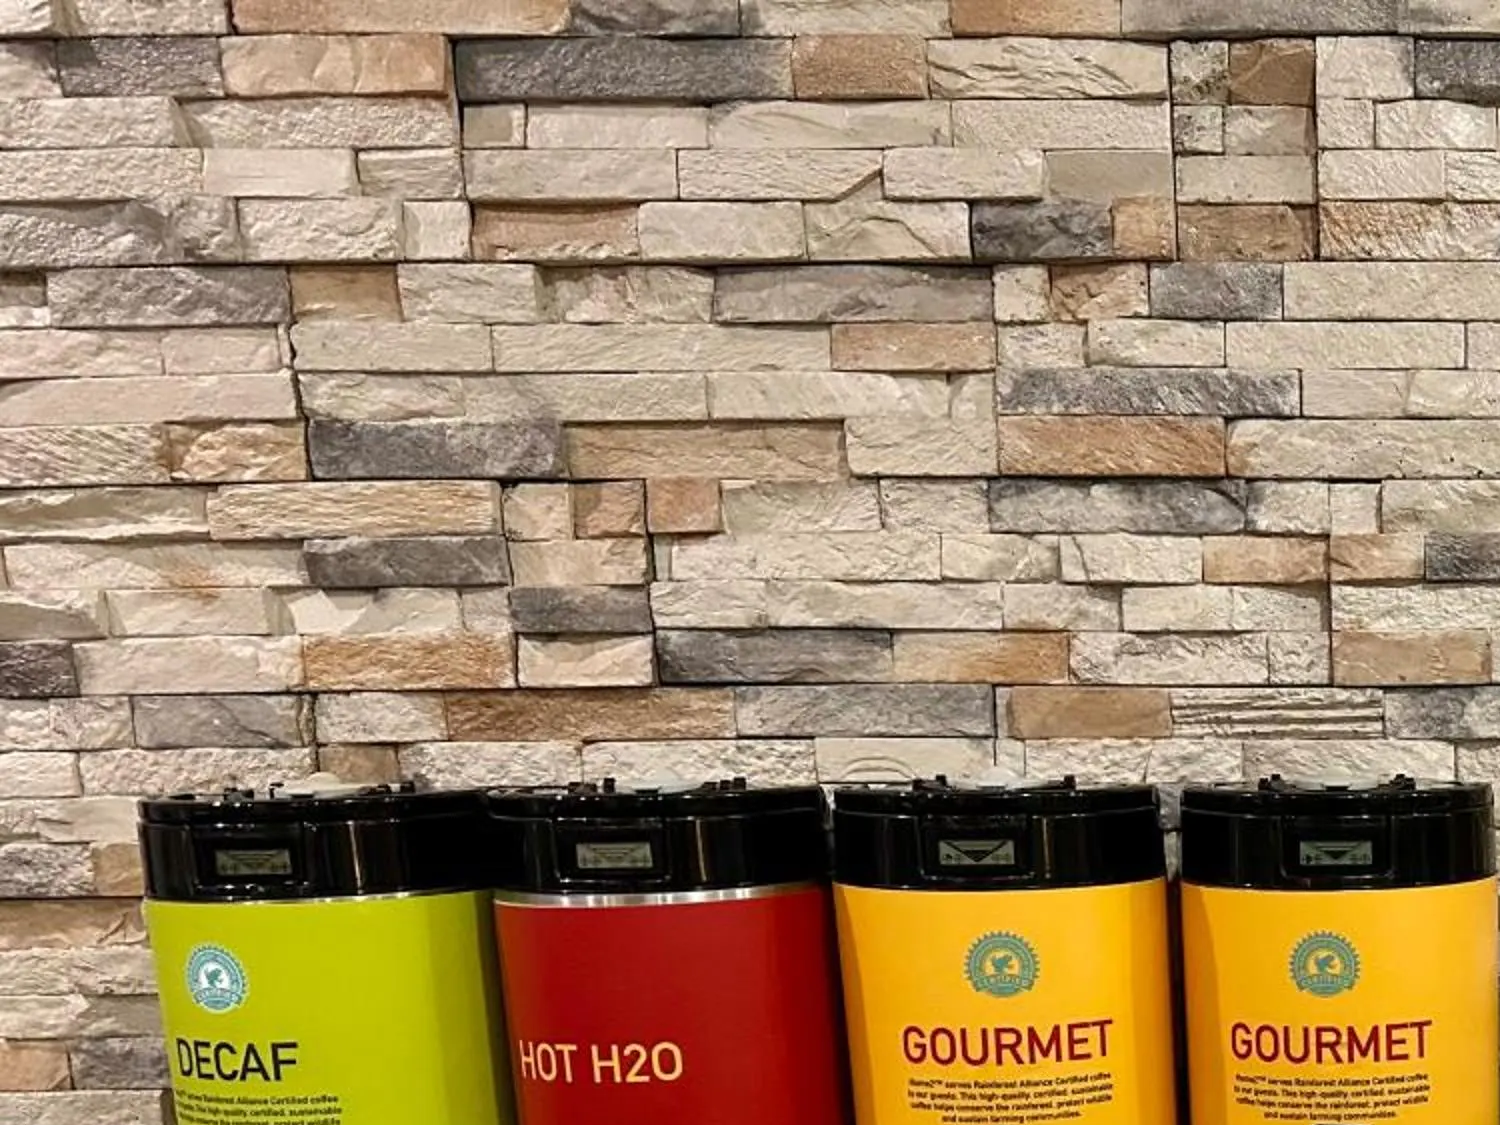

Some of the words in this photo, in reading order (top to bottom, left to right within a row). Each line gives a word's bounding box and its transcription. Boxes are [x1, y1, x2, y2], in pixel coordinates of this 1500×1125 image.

[176, 1038, 298, 1081] DECAF
[519, 1039, 578, 1083] HOT
[591, 1042, 683, 1083] H2O
[903, 1019, 1113, 1066] GOURMET
[1231, 1019, 1433, 1064] GOURMET
